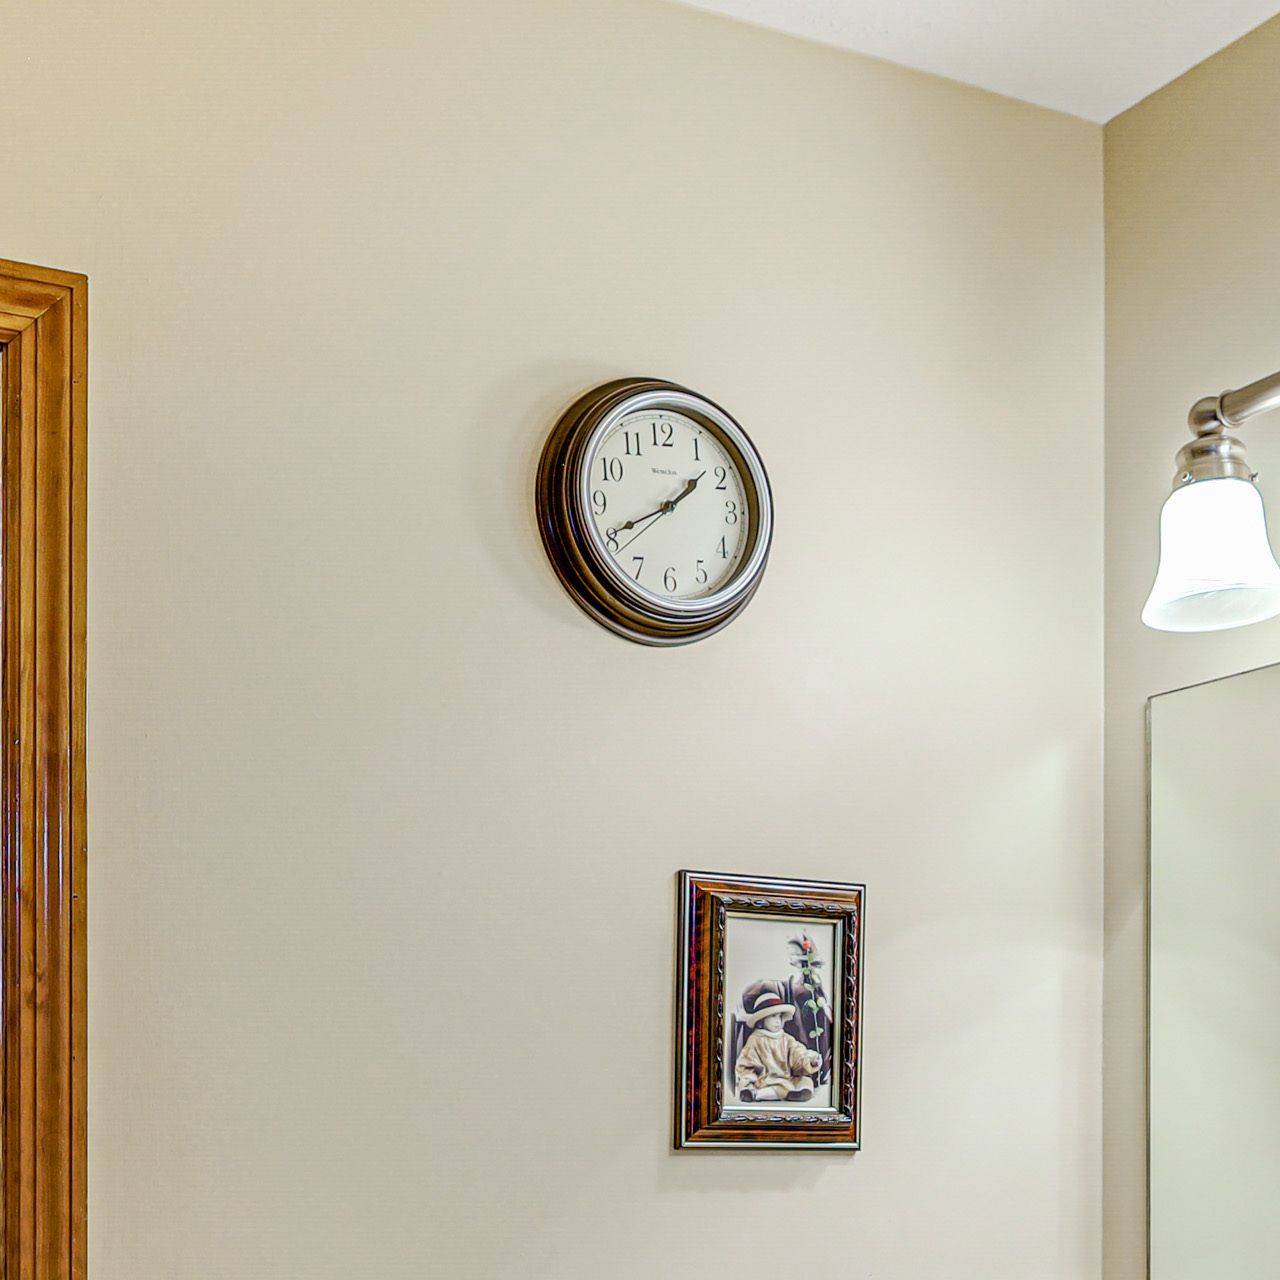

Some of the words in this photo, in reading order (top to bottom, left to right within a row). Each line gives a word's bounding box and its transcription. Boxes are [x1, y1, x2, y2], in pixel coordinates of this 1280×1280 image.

[623, 431, 643, 456] 11
[651, 423, 673, 447] 12
[693, 438, 700, 460] 1
[600, 457, 624, 482] 10
[714, 466, 727, 491] 2
[592, 490, 608, 516] 9
[725, 500, 738, 525] 3
[605, 527, 619, 553] 8
[716, 536, 728, 559] 4
[632, 557, 644, 580] 7
[663, 566, 678, 593] 6
[695, 559, 708, 584] 5
